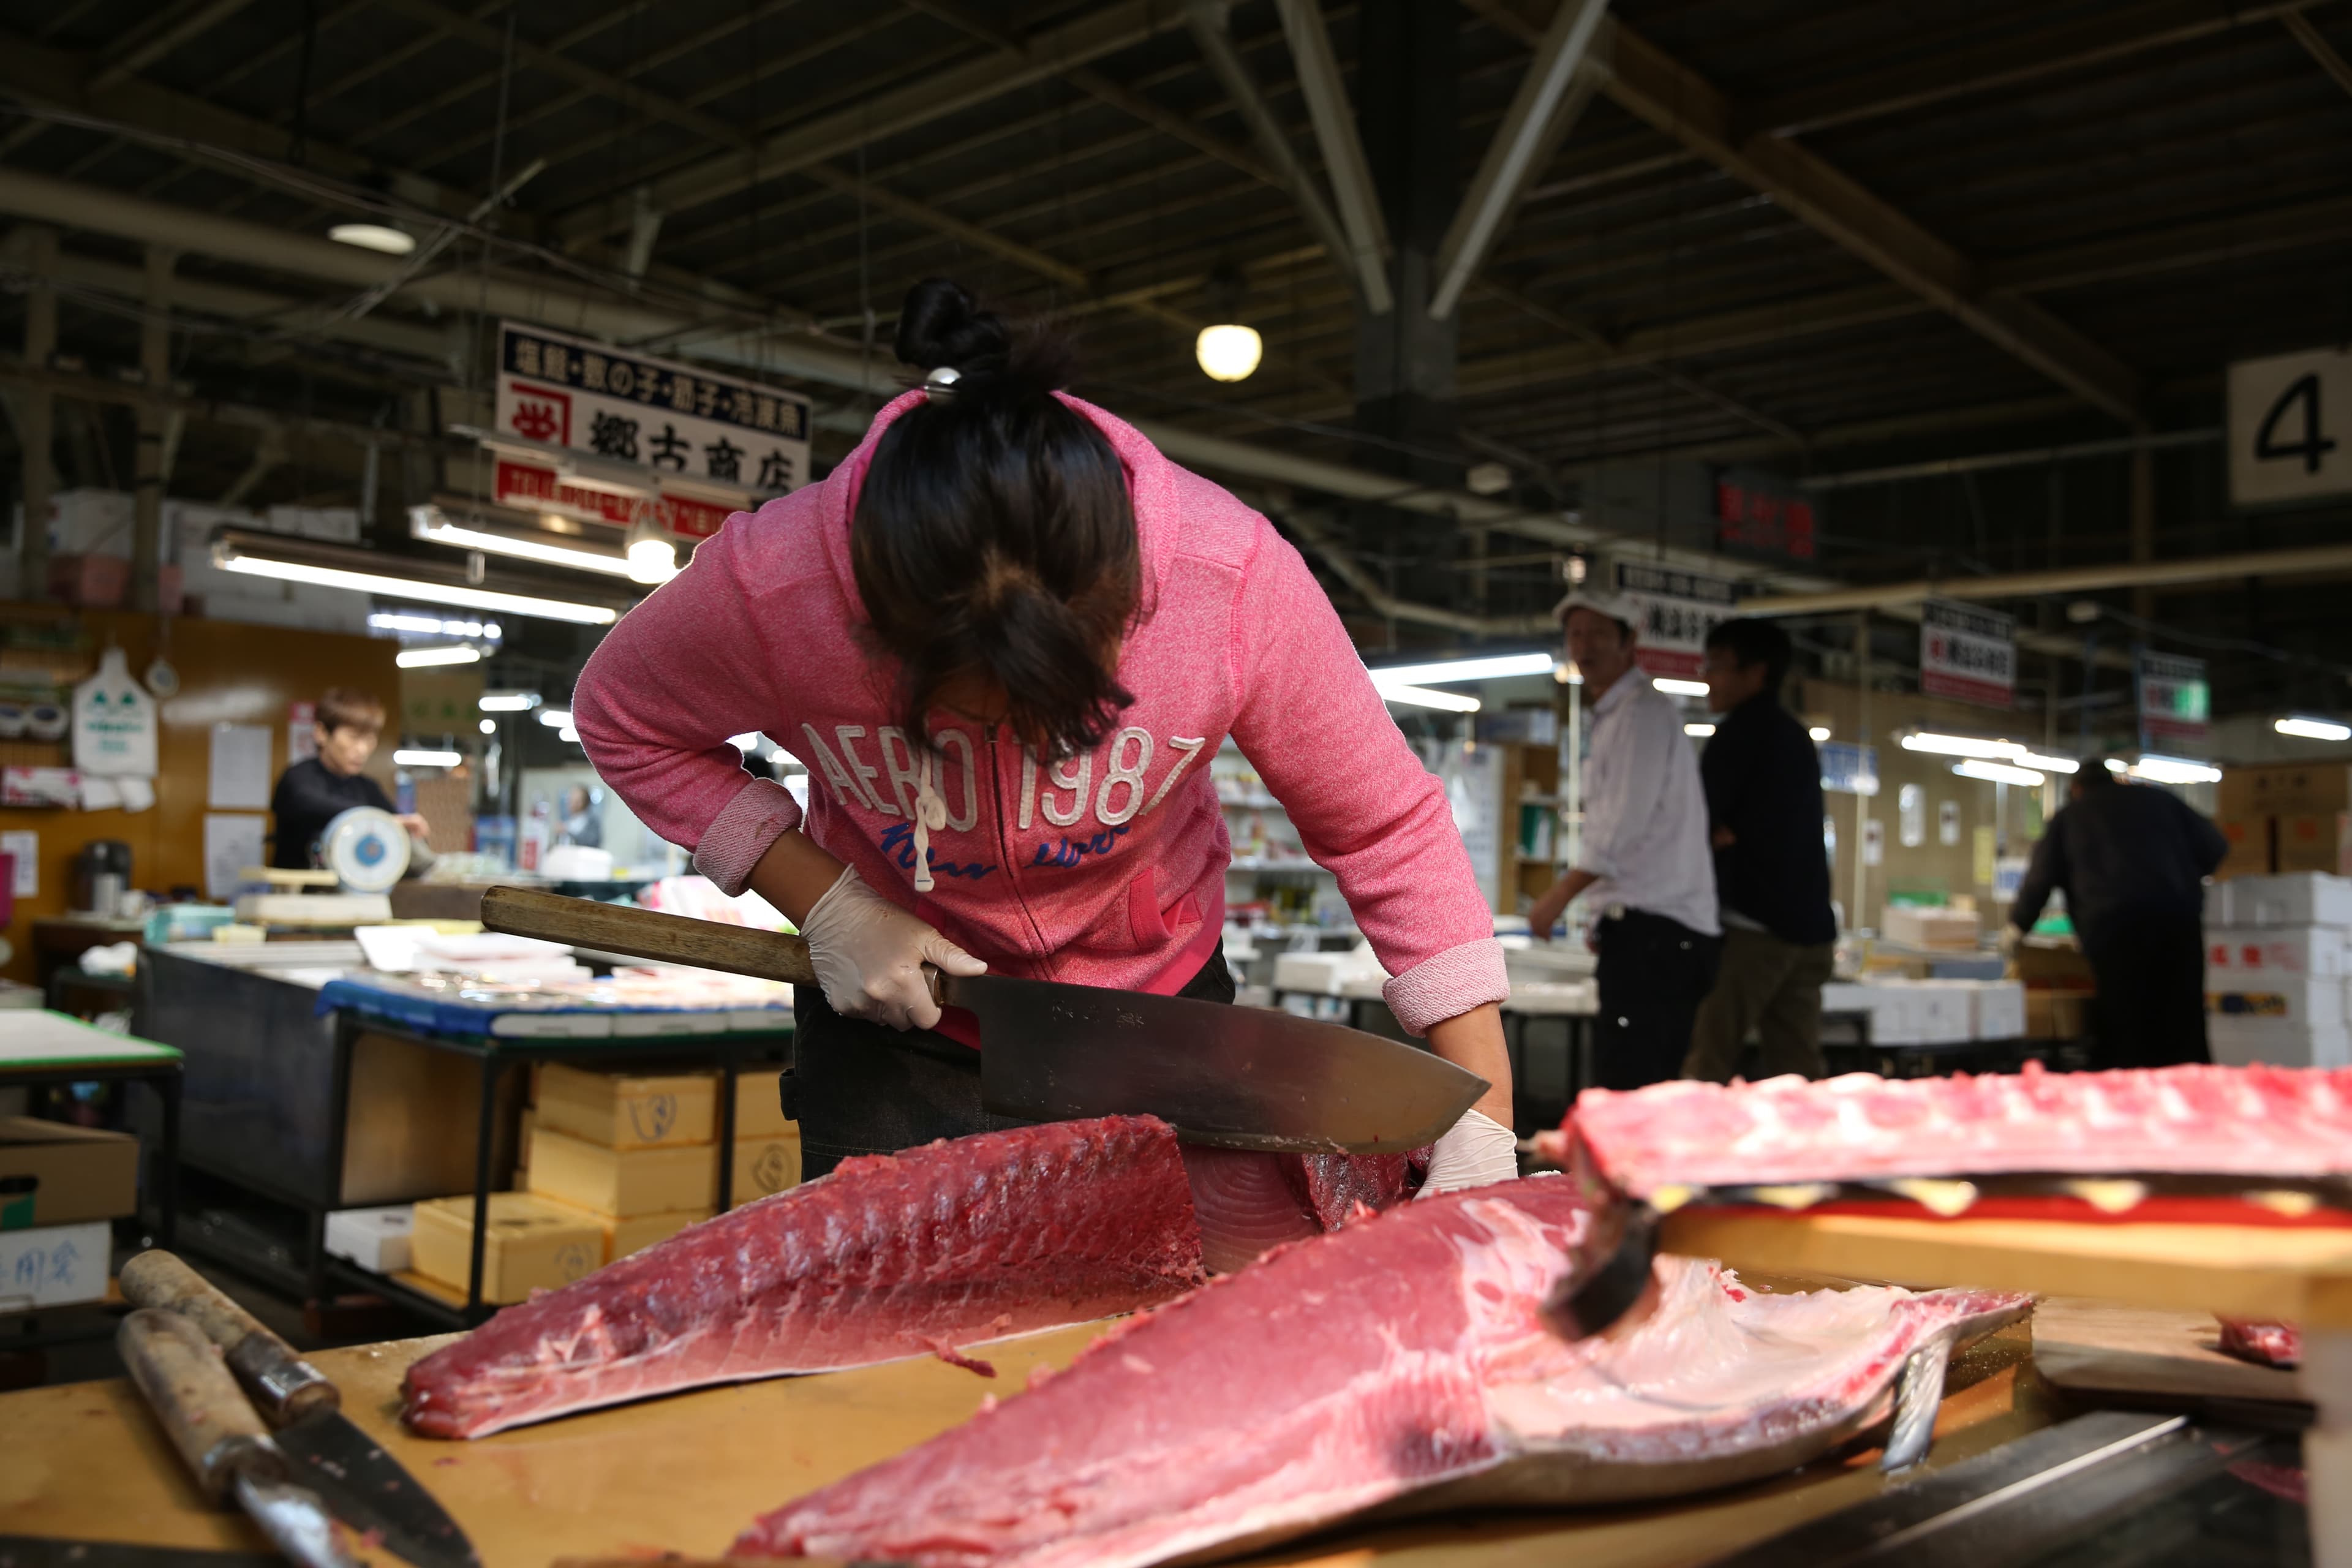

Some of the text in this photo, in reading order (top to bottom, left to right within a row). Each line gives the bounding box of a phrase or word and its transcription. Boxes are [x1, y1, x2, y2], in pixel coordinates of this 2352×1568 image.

[2255, 371, 2339, 475] 4
[801, 722, 1206, 832] AERO 1987
